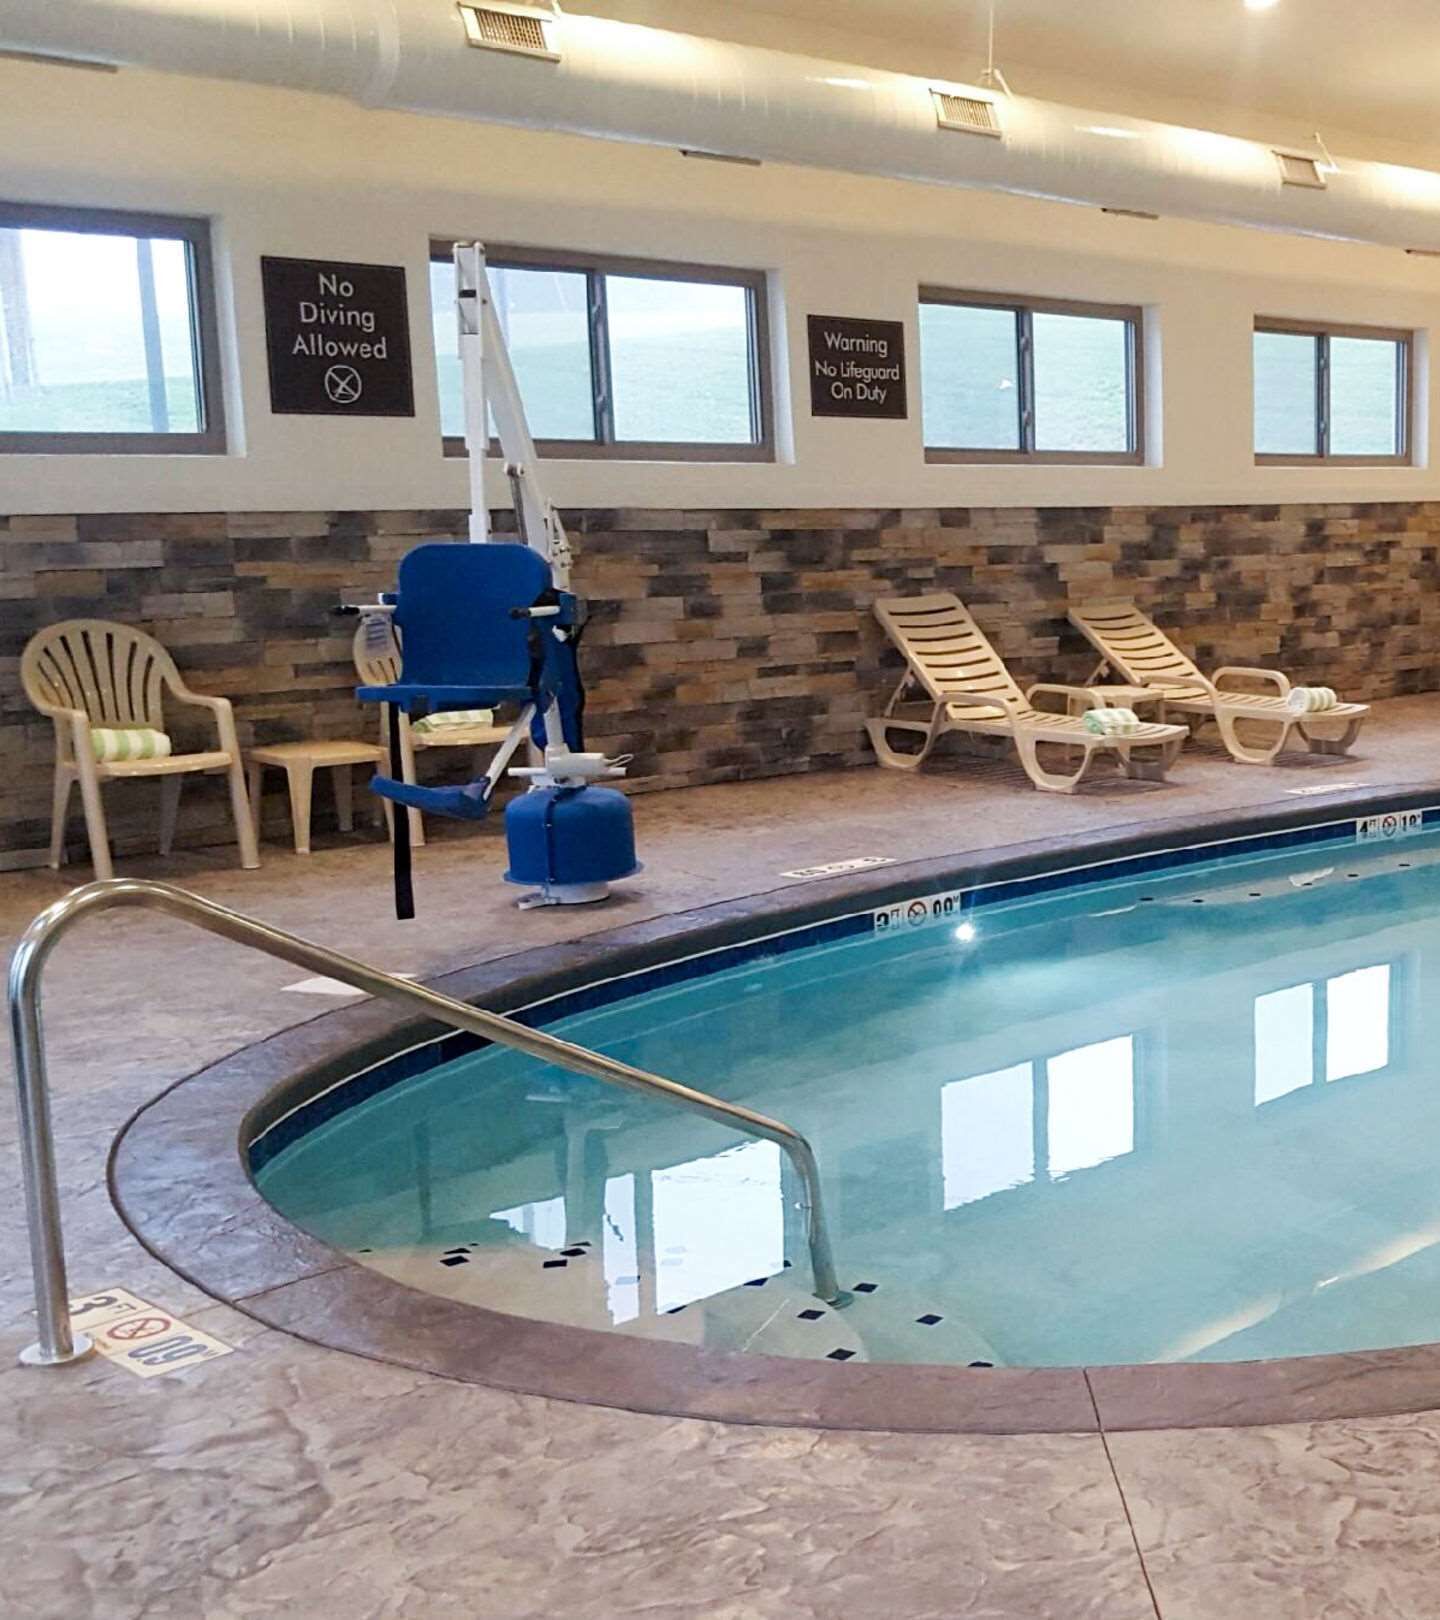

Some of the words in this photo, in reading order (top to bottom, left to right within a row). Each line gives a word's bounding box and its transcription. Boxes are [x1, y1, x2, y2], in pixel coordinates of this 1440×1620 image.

[319, 273, 354, 297] No
[300, 302, 376, 333] Diving
[291, 334, 389, 360] Allowed
[824, 331, 888, 358] Warning
[815, 360, 837, 377] No
[841, 361, 900, 383] Lifeguard
[831, 382, 852, 399] On
[856, 383, 887, 405] Duty
